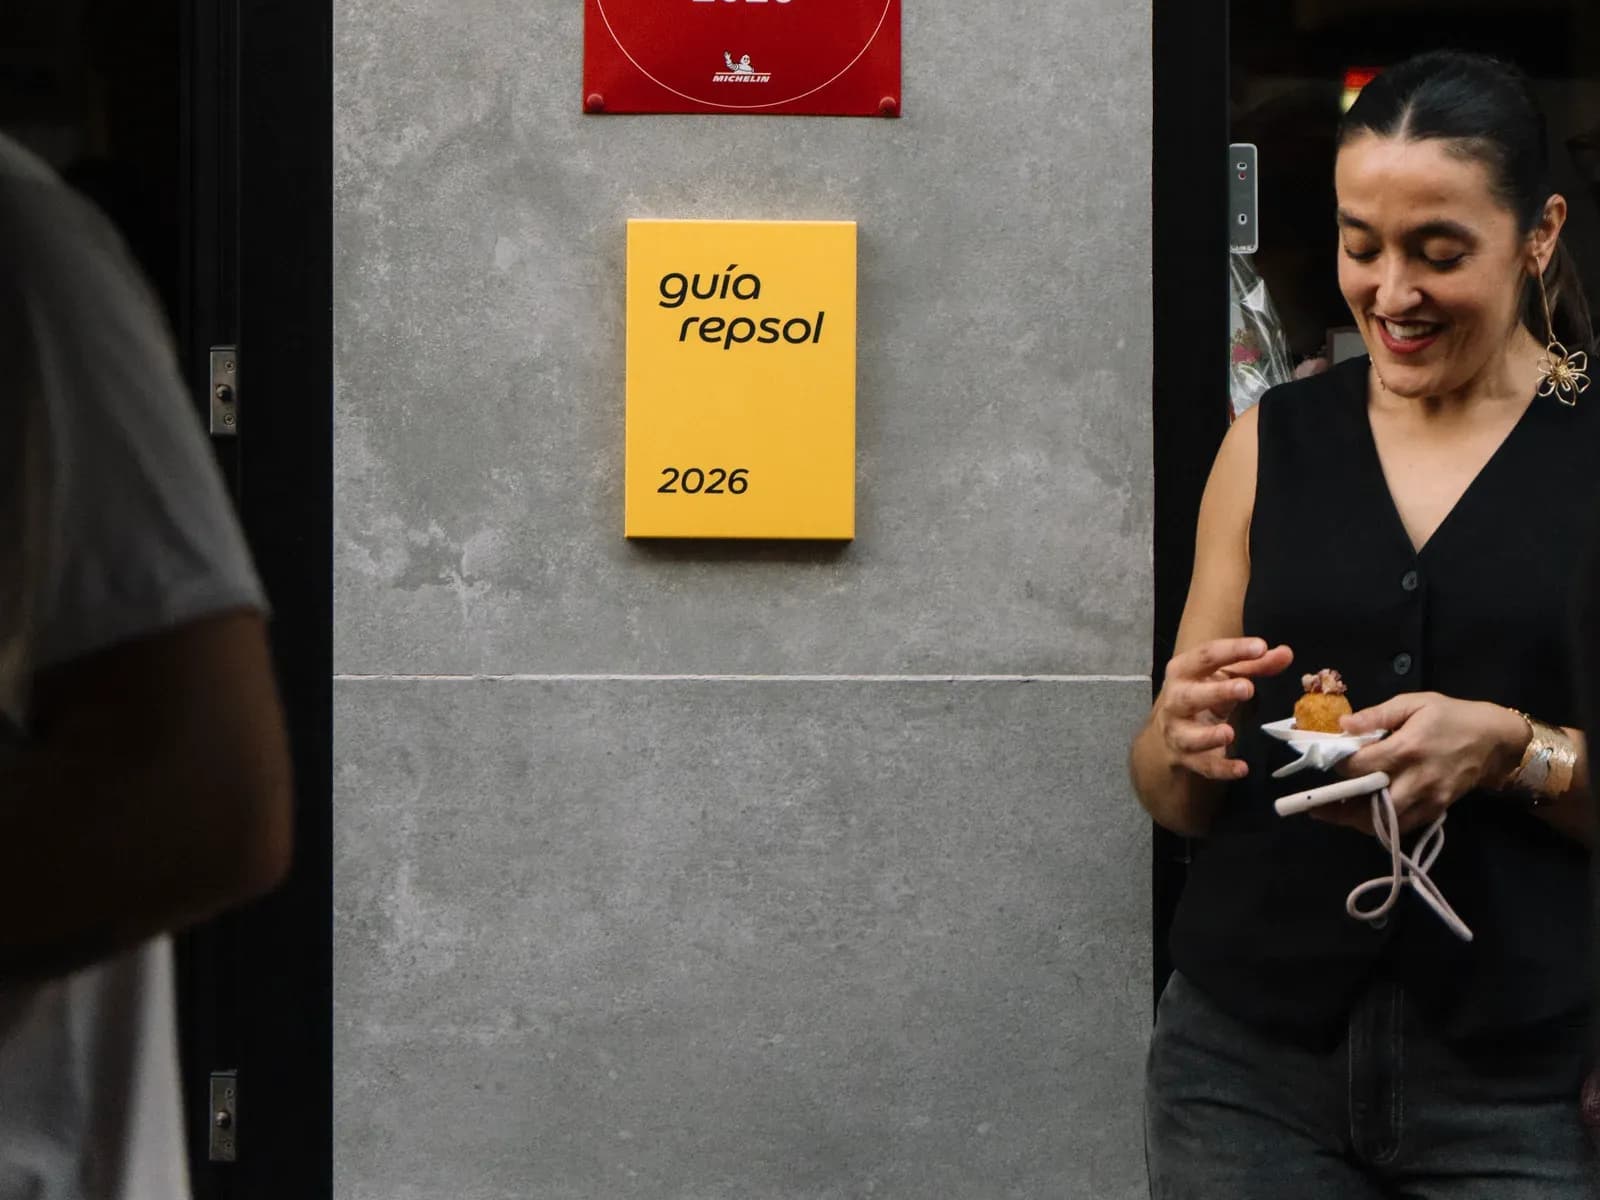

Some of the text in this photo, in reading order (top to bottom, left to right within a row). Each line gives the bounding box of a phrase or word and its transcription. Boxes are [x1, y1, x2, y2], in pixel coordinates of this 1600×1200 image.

[712, 75, 771, 83] MICHELIN
[658, 263, 761, 309] guía
[679, 311, 825, 351] repsol
[657, 467, 749, 495] 2026
